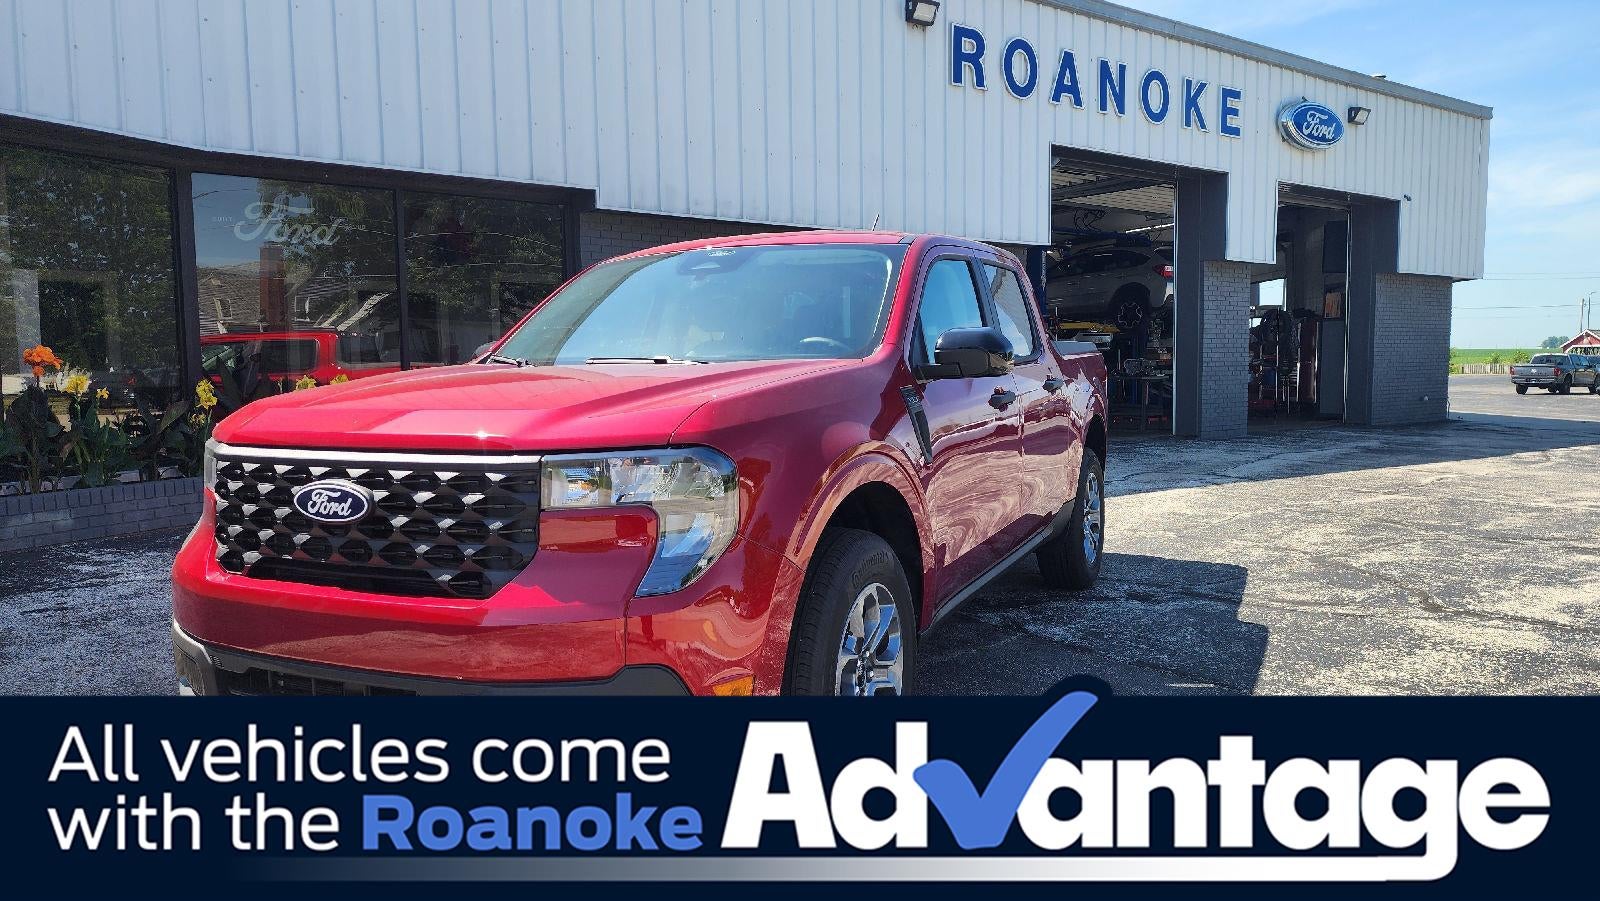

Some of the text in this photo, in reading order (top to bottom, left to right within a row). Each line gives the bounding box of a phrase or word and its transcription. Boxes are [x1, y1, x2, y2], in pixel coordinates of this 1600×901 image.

[951, 23, 1243, 138] ROANOKE
[1302, 110, 1337, 140] Ford
[234, 201, 345, 246] Ford
[307, 489, 353, 517] Ford
